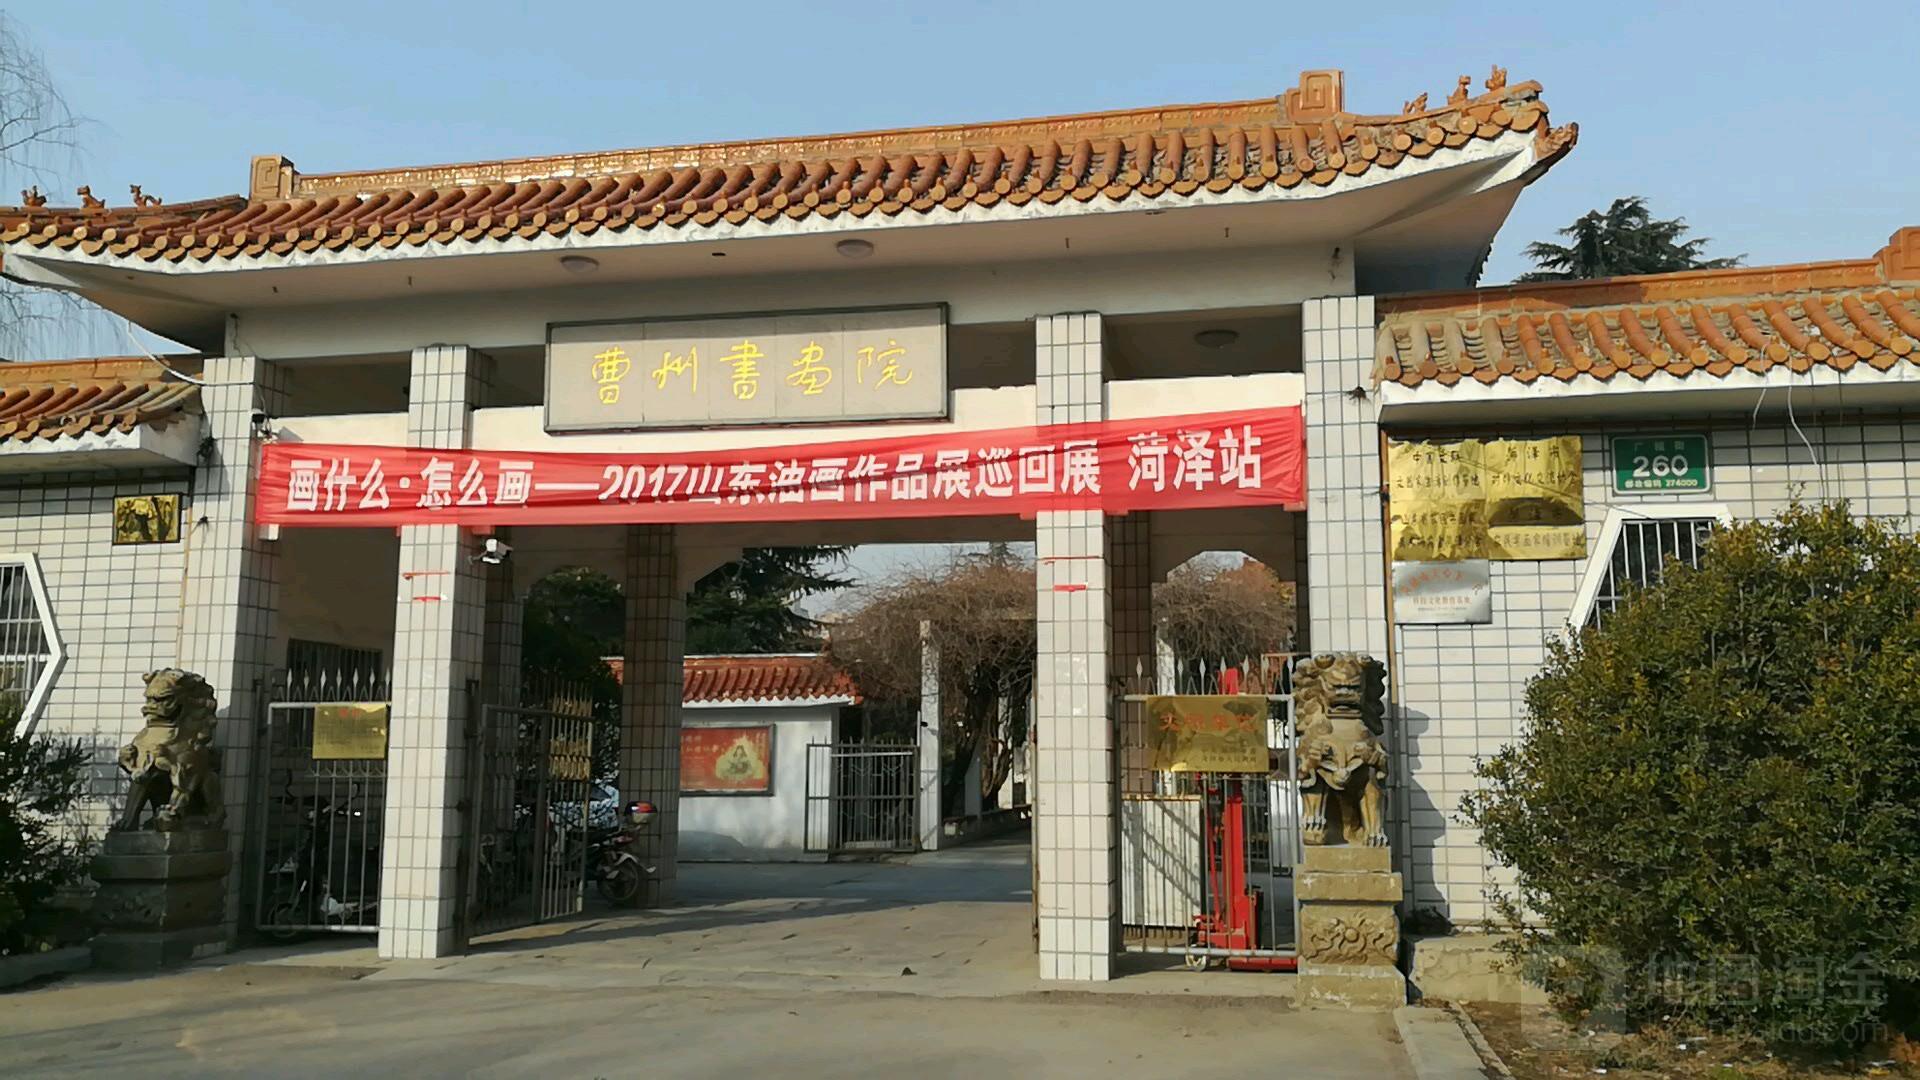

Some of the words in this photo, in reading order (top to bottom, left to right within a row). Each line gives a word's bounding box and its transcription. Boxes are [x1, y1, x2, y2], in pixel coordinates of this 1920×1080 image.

[1127, 424, 1262, 492] 菏泽站
[1632, 455, 1688, 477] 260
